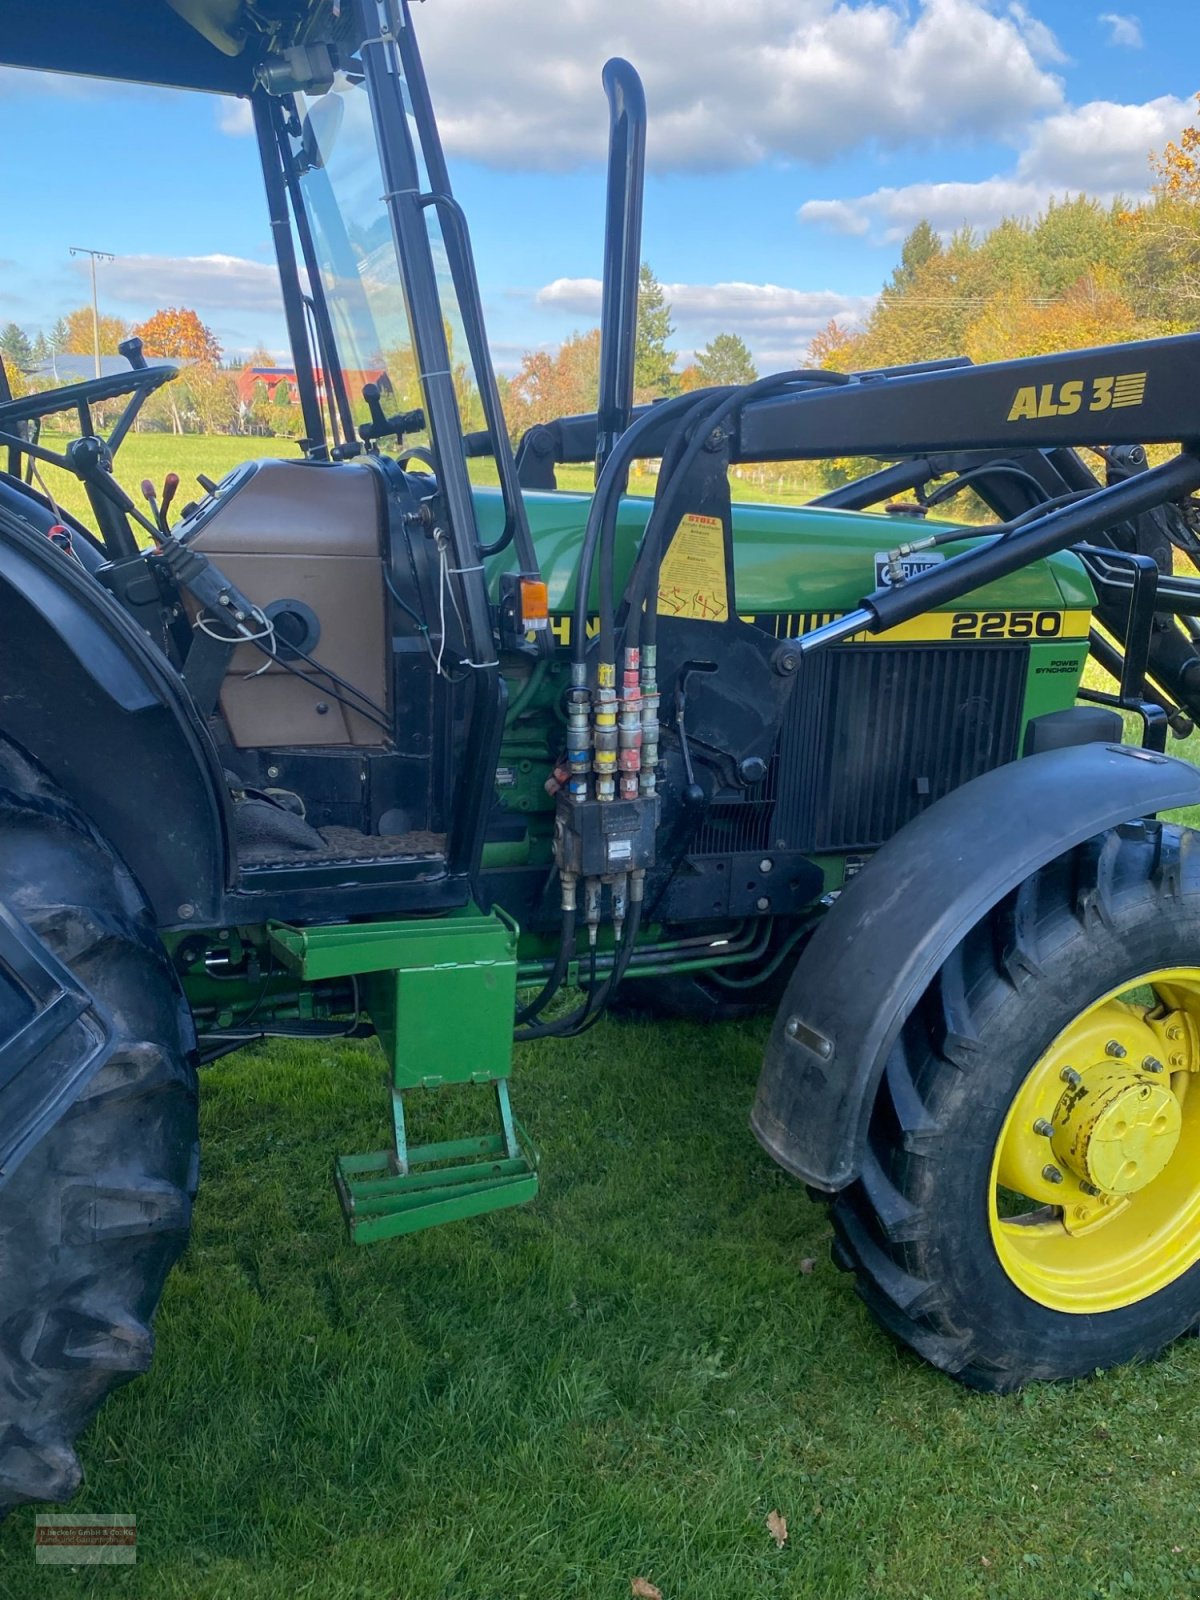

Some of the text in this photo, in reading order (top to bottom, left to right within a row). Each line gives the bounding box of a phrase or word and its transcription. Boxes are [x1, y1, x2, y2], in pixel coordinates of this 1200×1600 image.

[1006, 376, 1115, 422] ALS 3
[688, 515, 717, 526] STOLL
[951, 611, 1061, 639] 2250
[1035, 666, 1079, 674] SYNCHRON
